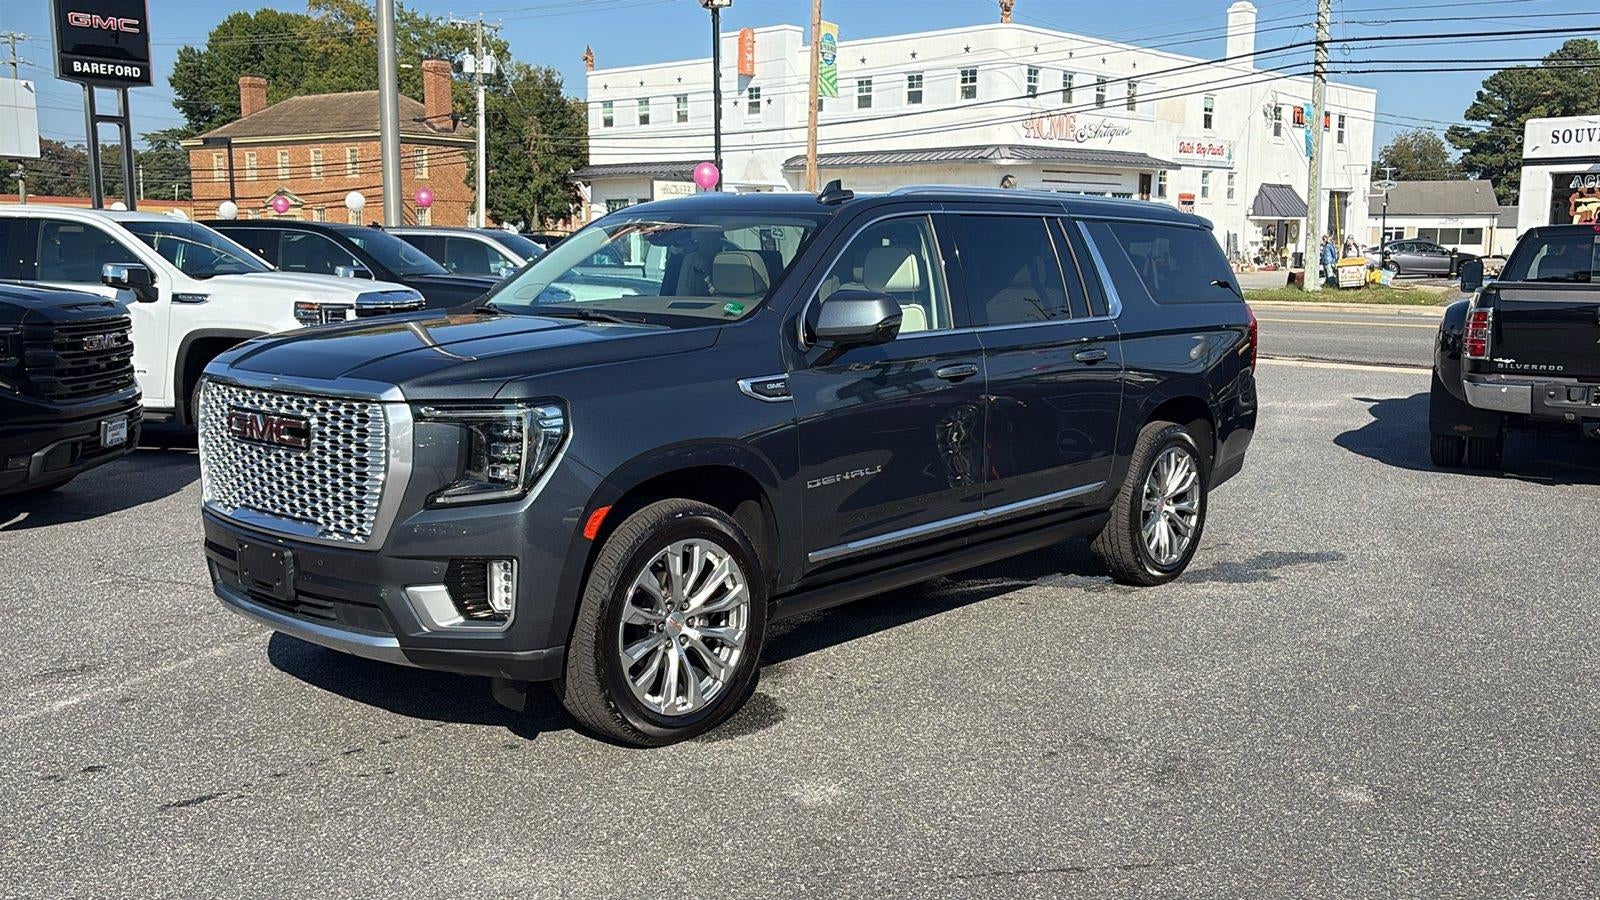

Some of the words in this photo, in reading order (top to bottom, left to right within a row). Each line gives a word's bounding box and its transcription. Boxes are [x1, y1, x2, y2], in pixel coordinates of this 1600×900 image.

[67, 11, 140, 34] GMC
[73, 60, 141, 78] BAREFORD
[1022, 112, 1077, 142] ACME
[1196, 143, 1208, 158] Boy
[1569, 175, 1600, 189] AC
[83, 332, 122, 351] GMC
[1497, 363, 1564, 371] SILVERADO
[766, 381, 786, 389] GMC
[229, 408, 307, 448] GMC
[807, 465, 882, 489] DENALI
